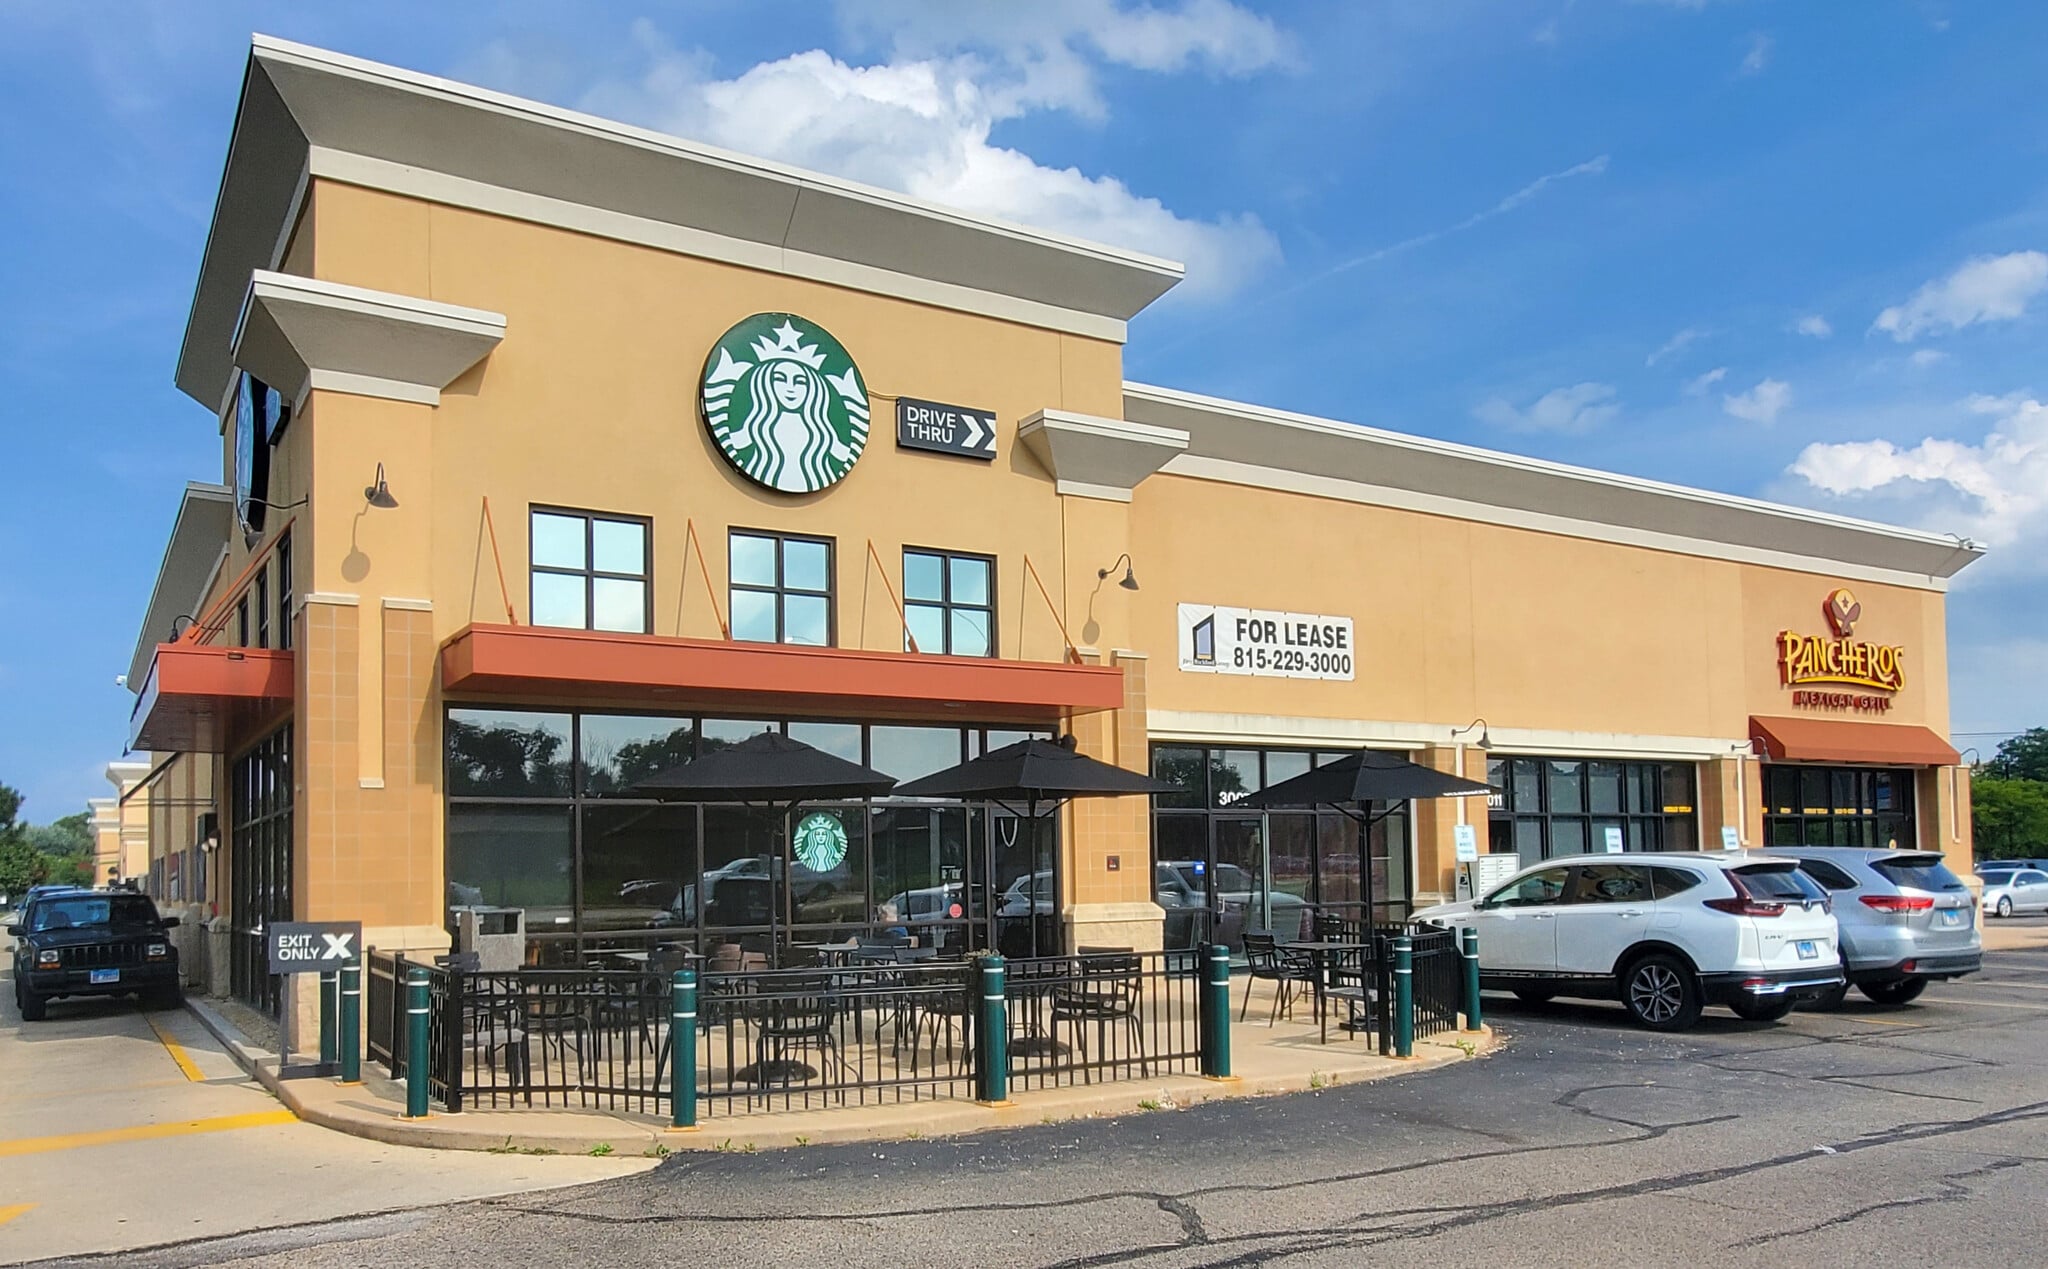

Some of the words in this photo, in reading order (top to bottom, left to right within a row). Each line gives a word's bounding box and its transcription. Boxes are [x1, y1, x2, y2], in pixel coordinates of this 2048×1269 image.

[907, 406, 956, 428] DRIVE
[907, 423, 953, 444] THRU
[1236, 618, 1278, 644] FOR
[1284, 622, 1347, 649] LEASE
[1234, 647, 1351, 674] 815-229-3000
[1784, 630, 1906, 691] PANCHEROS
[1798, 690, 1854, 707] MEXICAN
[1219, 791, 1250, 806] 300
[278, 934, 313, 948] EXIT
[278, 947, 320, 960] ONLY
